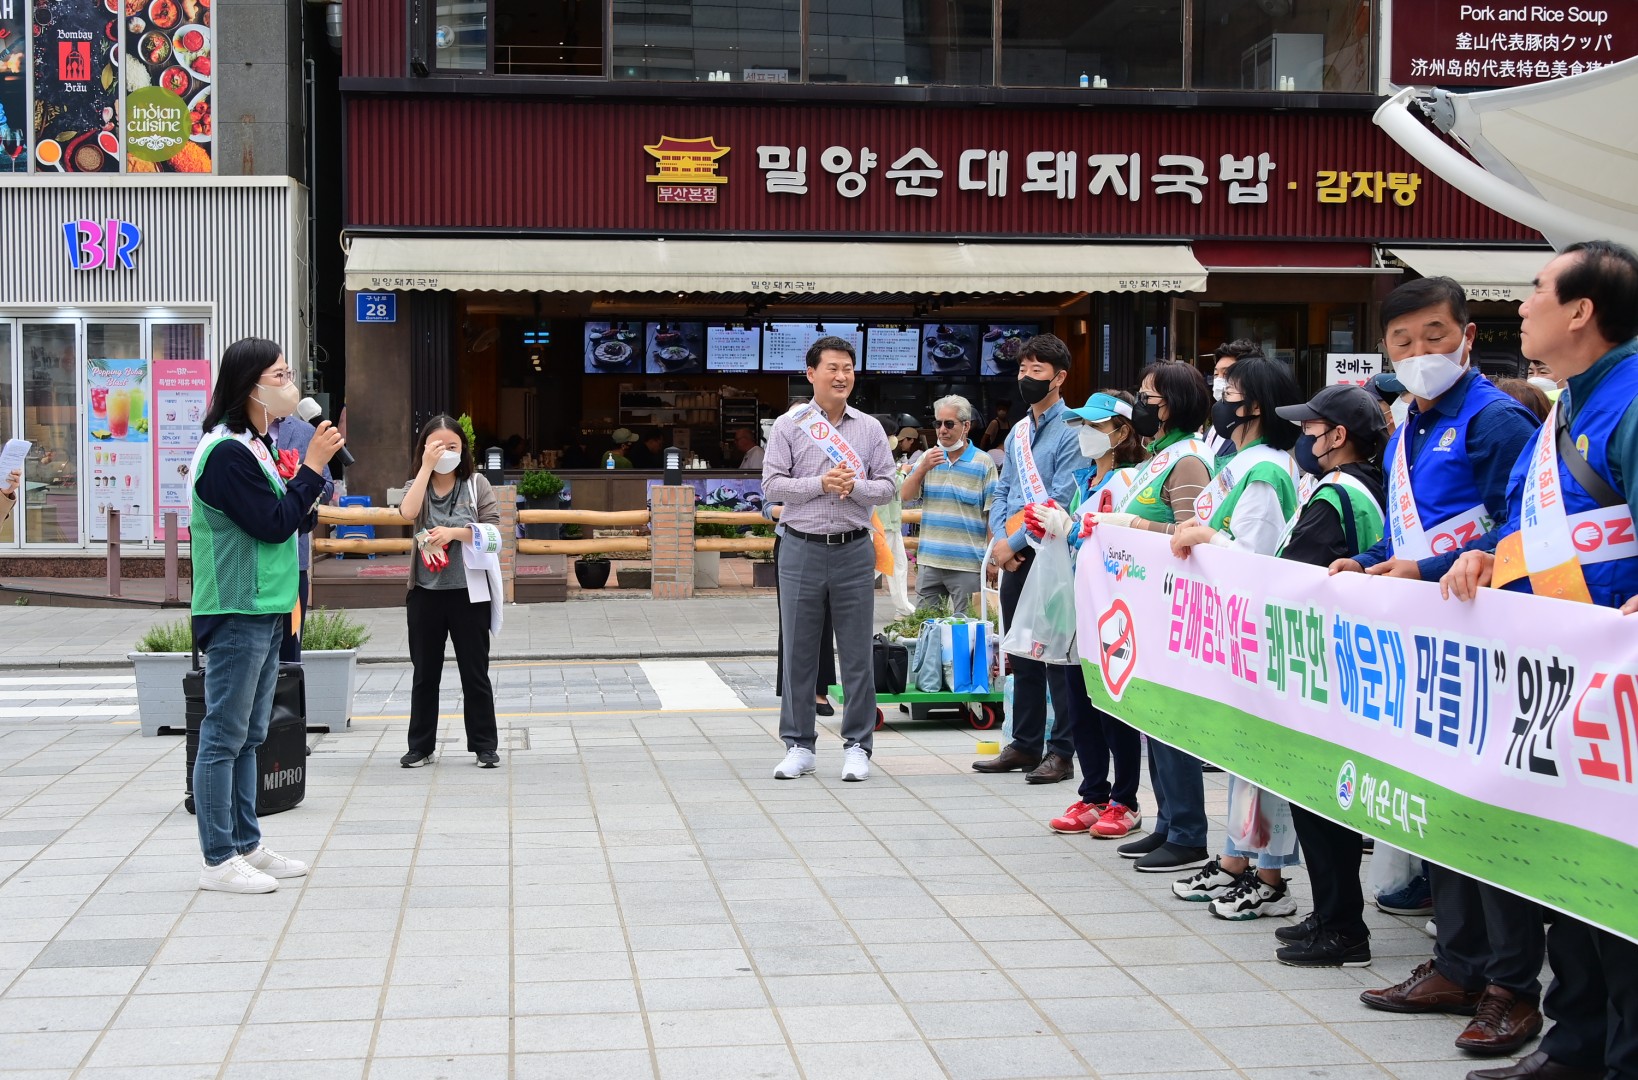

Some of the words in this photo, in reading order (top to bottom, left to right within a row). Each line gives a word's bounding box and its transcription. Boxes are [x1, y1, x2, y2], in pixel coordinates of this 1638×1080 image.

[1460, 5, 1495, 21] Pork
[1499, 6, 1527, 21] and
[1531, 6, 1564, 22] Rice
[1568, 7, 1608, 25] Soup
[57, 29, 93, 41] Bombay
[1455, 32, 1612, 51] 釜山代表豚肉クッパ
[64, 82, 88, 93] Bräu
[133, 103, 181, 119] indian
[127, 119, 180, 132] cuisine
[756, 145, 1276, 204] 밀양순대돼지국밥
[1316, 170, 1421, 205] 감자탕
[658, 187, 717, 202] 부산본점
[62, 218, 142, 271] BR
[366, 303, 387, 317] 28
[92, 367, 123, 378] Popping
[1335, 358, 1373, 374] 전메뉴
[106, 377, 129, 387] Blast
[159, 379, 177, 387] 특별한
[178, 379, 190, 387] 제휴
[1109, 546, 1132, 562] Sun&Fun
[1103, 551, 1147, 582] Haeundae
[1227, 594, 1259, 684] 없는
[1265, 603, 1328, 704] 쾌적한
[1333, 614, 1406, 728] 해운대
[1504, 655, 1575, 777] 위한
[264, 766, 303, 791] MIPRO
[1360, 773, 1428, 839] 해운대구
